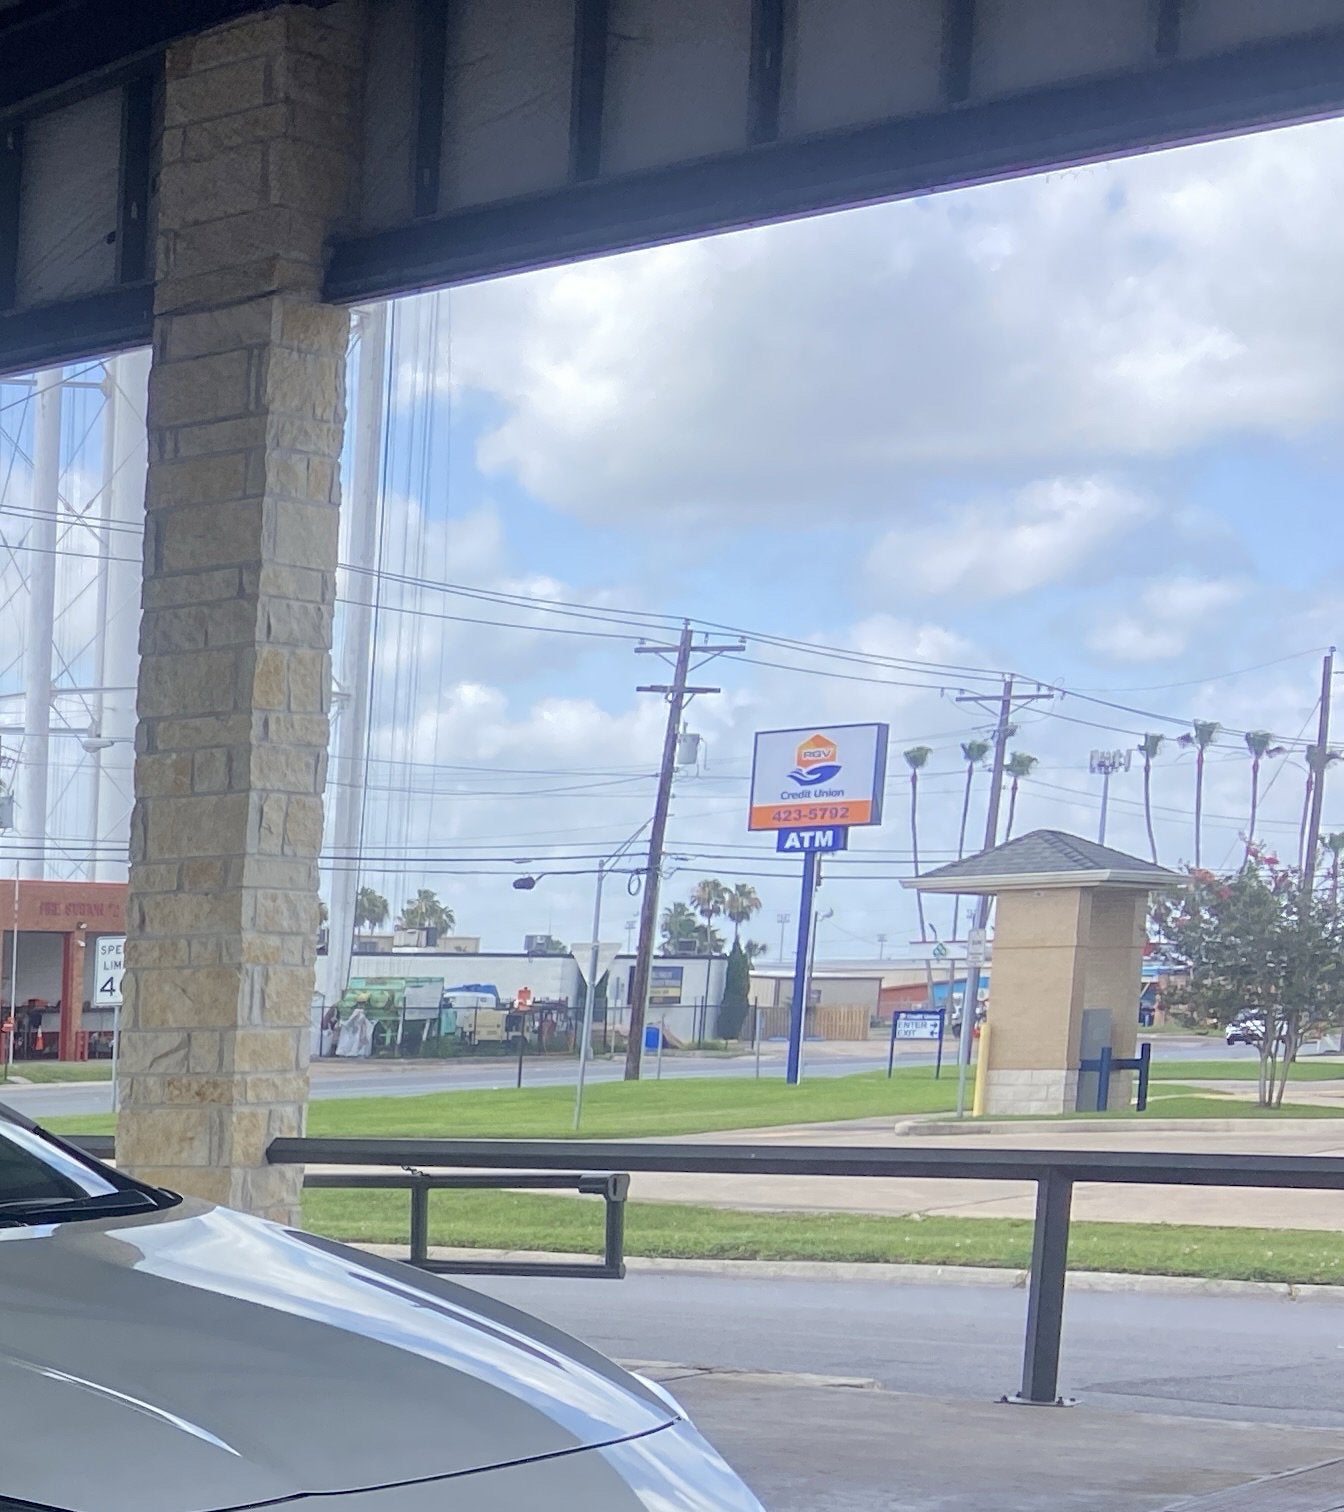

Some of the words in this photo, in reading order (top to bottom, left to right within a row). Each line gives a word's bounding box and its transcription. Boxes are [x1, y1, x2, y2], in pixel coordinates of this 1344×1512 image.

[803, 750, 831, 758] RGV
[780, 790, 811, 800] Credit
[814, 788, 844, 798] Union
[784, 830, 833, 849] ATM
[100, 945, 122, 955] SPE
[103, 961, 122, 971] LIM
[100, 976, 122, 997] 4
